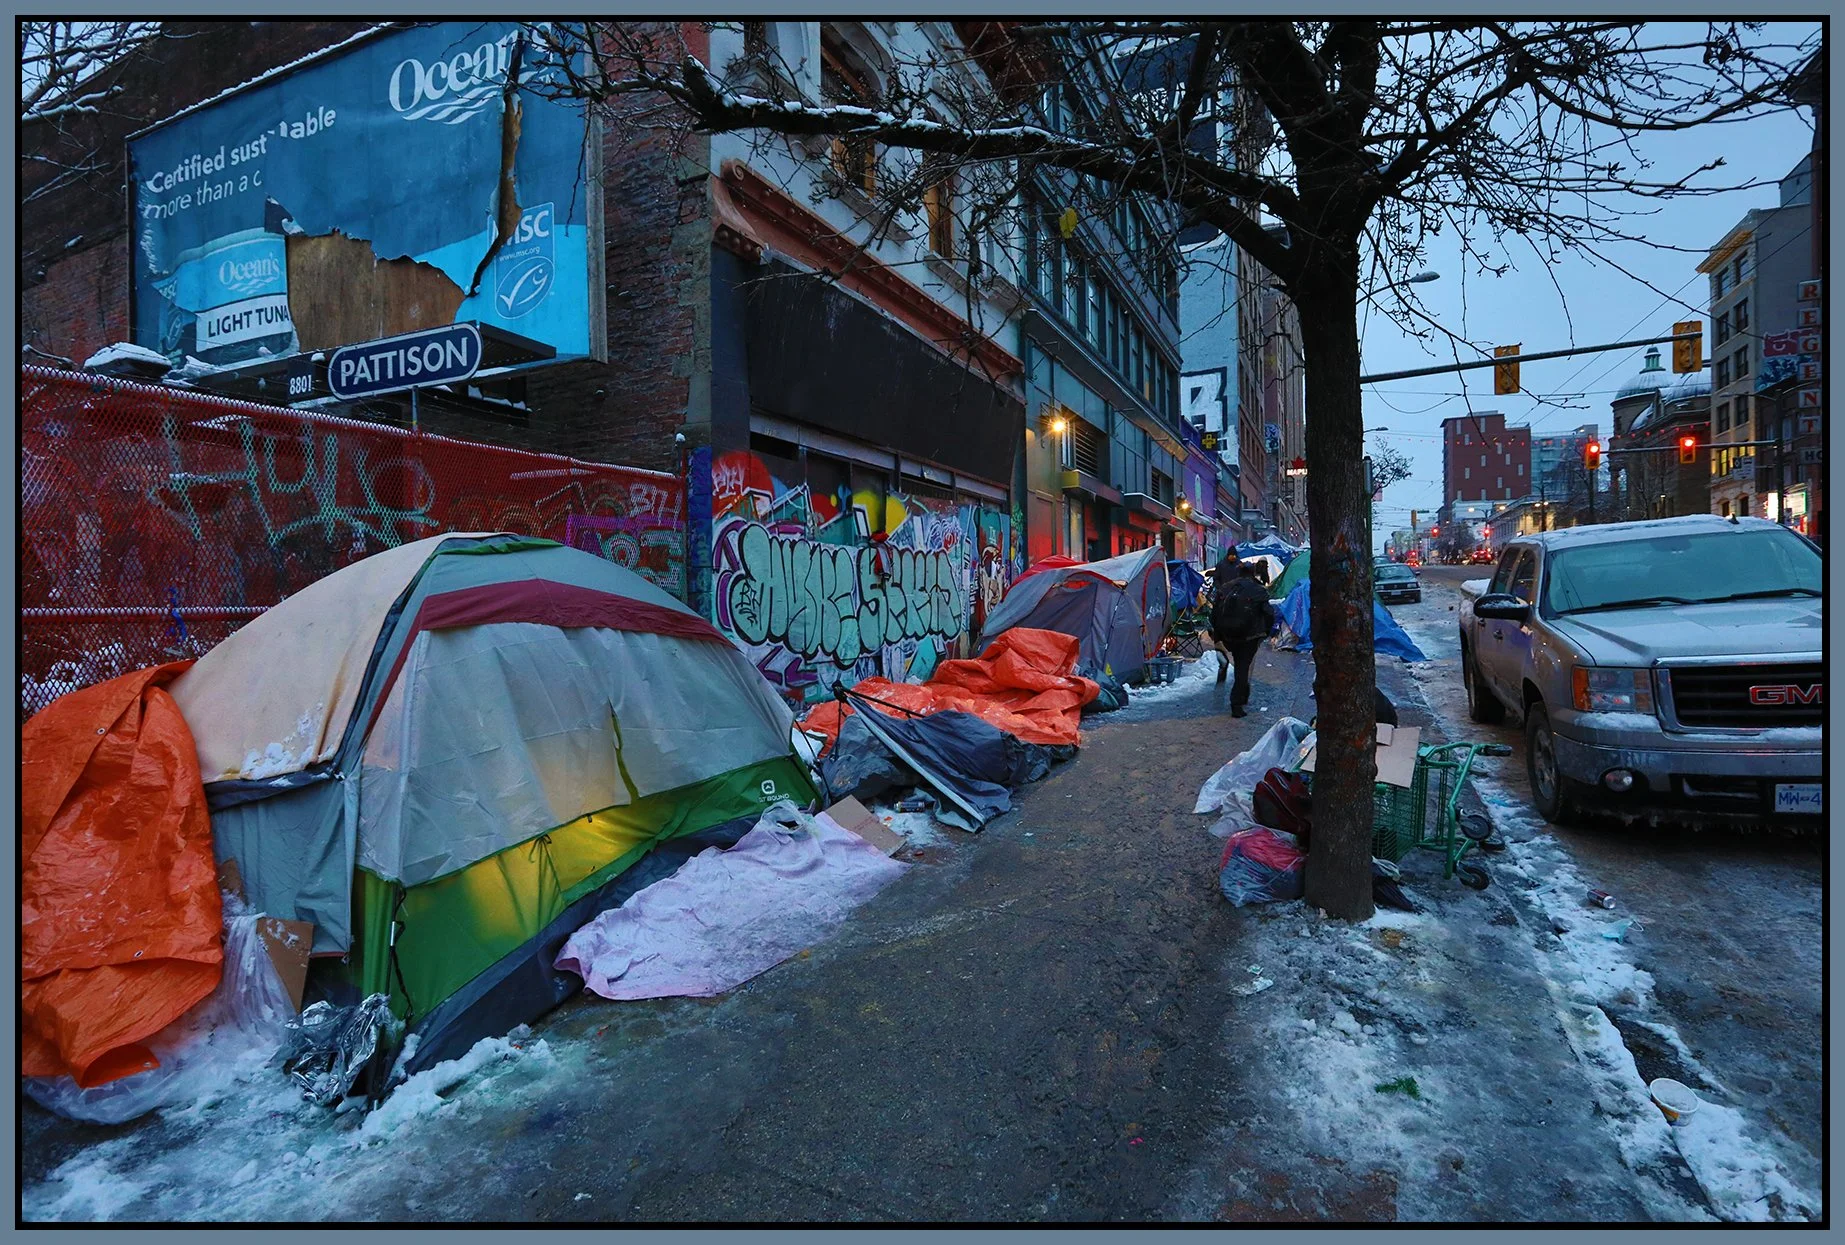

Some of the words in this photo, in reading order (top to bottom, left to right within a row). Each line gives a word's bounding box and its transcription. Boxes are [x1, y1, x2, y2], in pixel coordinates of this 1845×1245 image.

[147, 146, 225, 193] Certified
[145, 193, 192, 219] more
[197, 180, 234, 206] than
[238, 175, 248, 192] a
[219, 252, 280, 285] Ocean's
[208, 311, 252, 338] LIGHT
[255, 305, 290, 326] TUNA
[341, 336, 469, 388] PATTISON
[1802, 283, 1820, 433] REGENT
[289, 374, 313, 396] 8801
